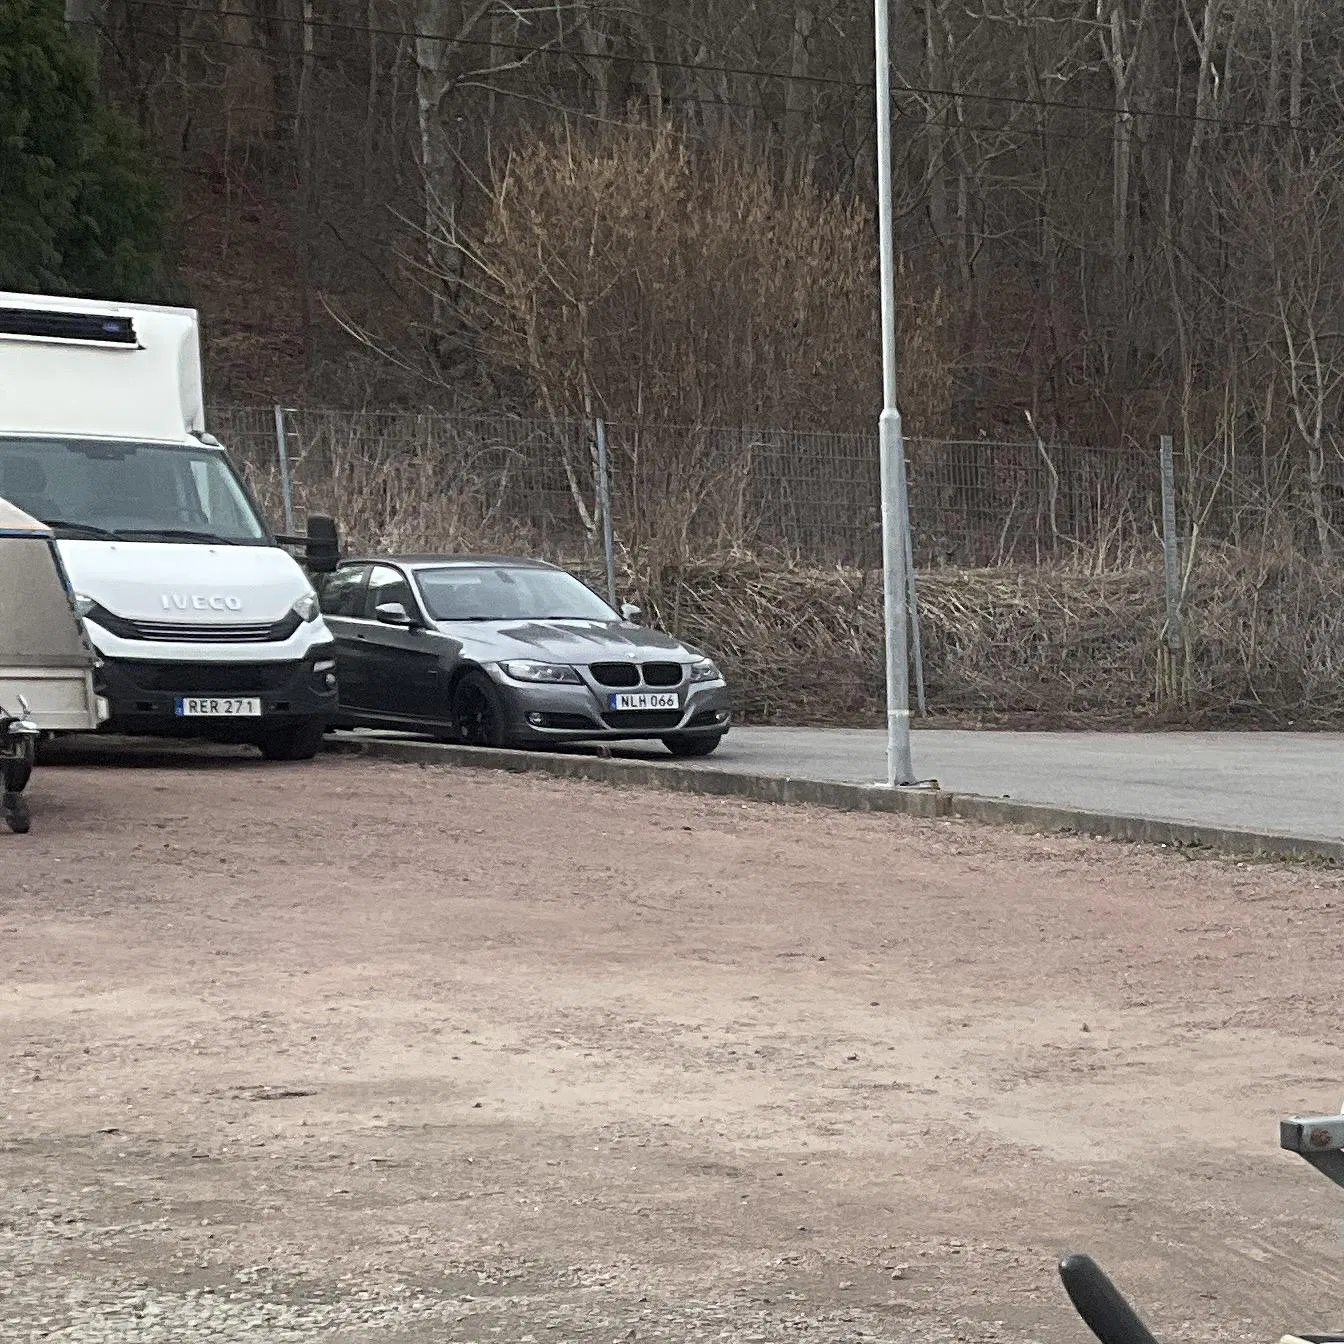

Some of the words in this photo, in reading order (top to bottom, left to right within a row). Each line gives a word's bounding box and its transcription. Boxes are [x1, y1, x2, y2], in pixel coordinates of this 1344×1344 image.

[160, 593, 242, 611] IVECO
[188, 700, 219, 714] RER
[224, 700, 253, 714] 271
[620, 695, 648, 708] NLH
[650, 694, 675, 707] 066
